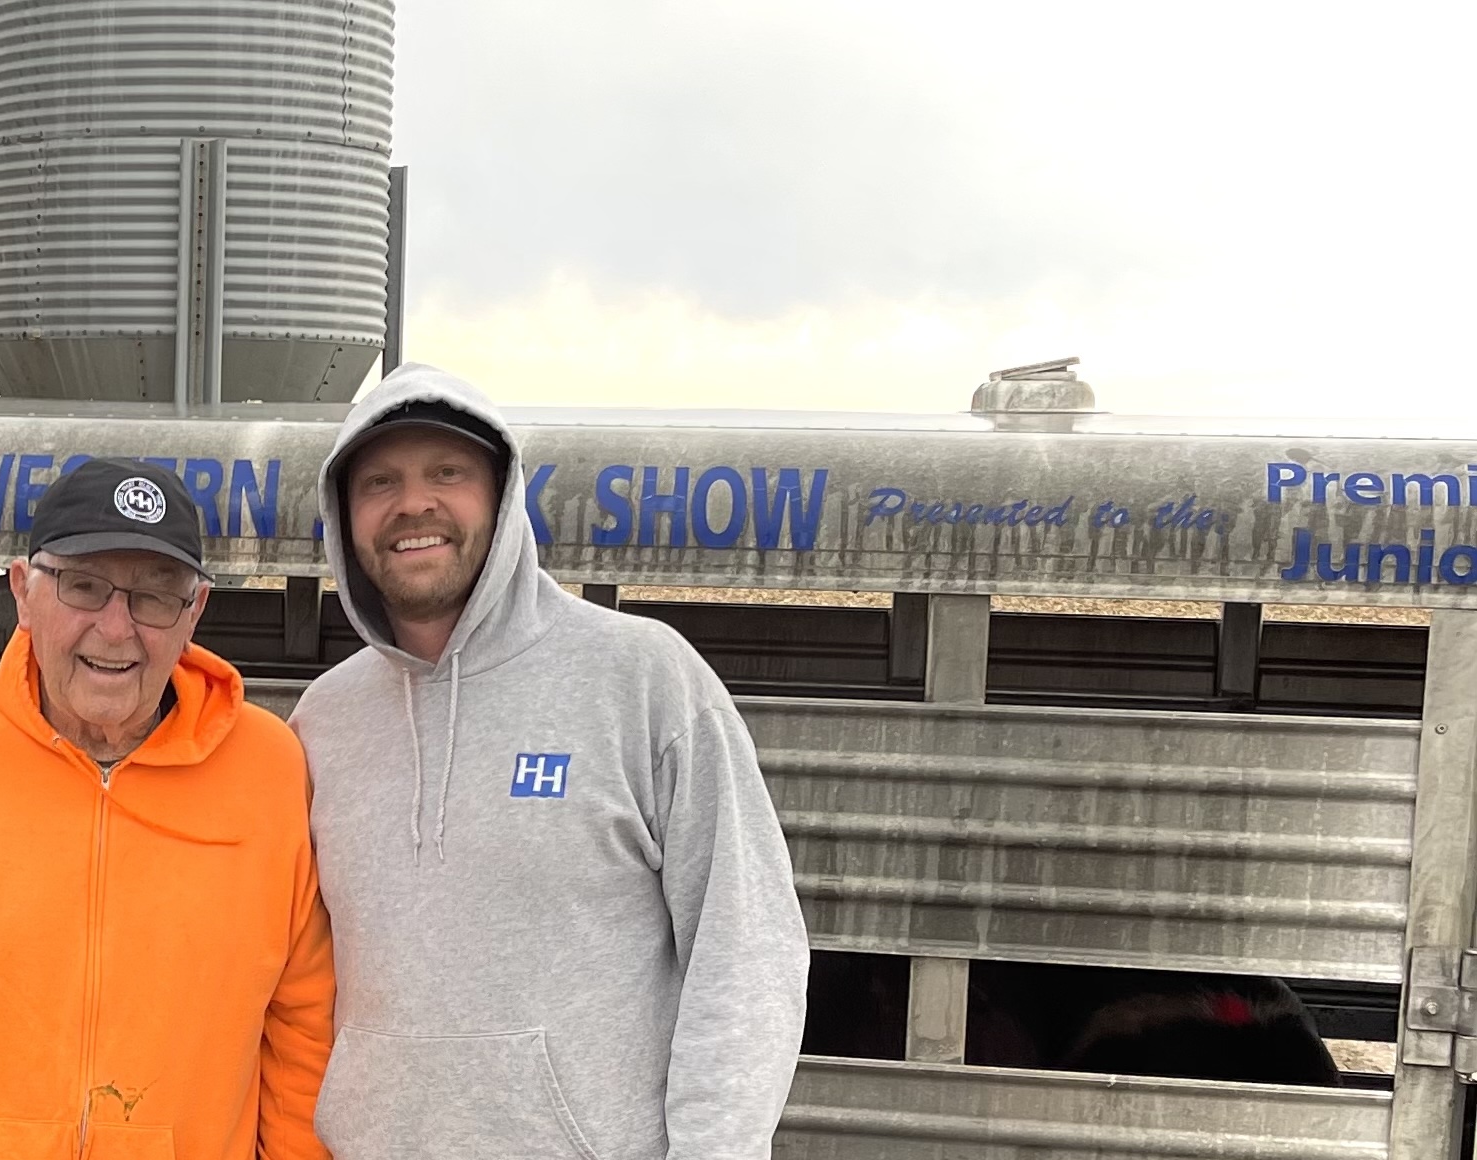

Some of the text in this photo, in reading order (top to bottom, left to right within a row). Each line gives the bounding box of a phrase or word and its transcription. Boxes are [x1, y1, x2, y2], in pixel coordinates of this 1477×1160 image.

[591, 464, 830, 551] SHOW
[865, 486, 1075, 527] Presented
[1093, 500, 1129, 529] to
[1280, 527, 1477, 584] Junio
